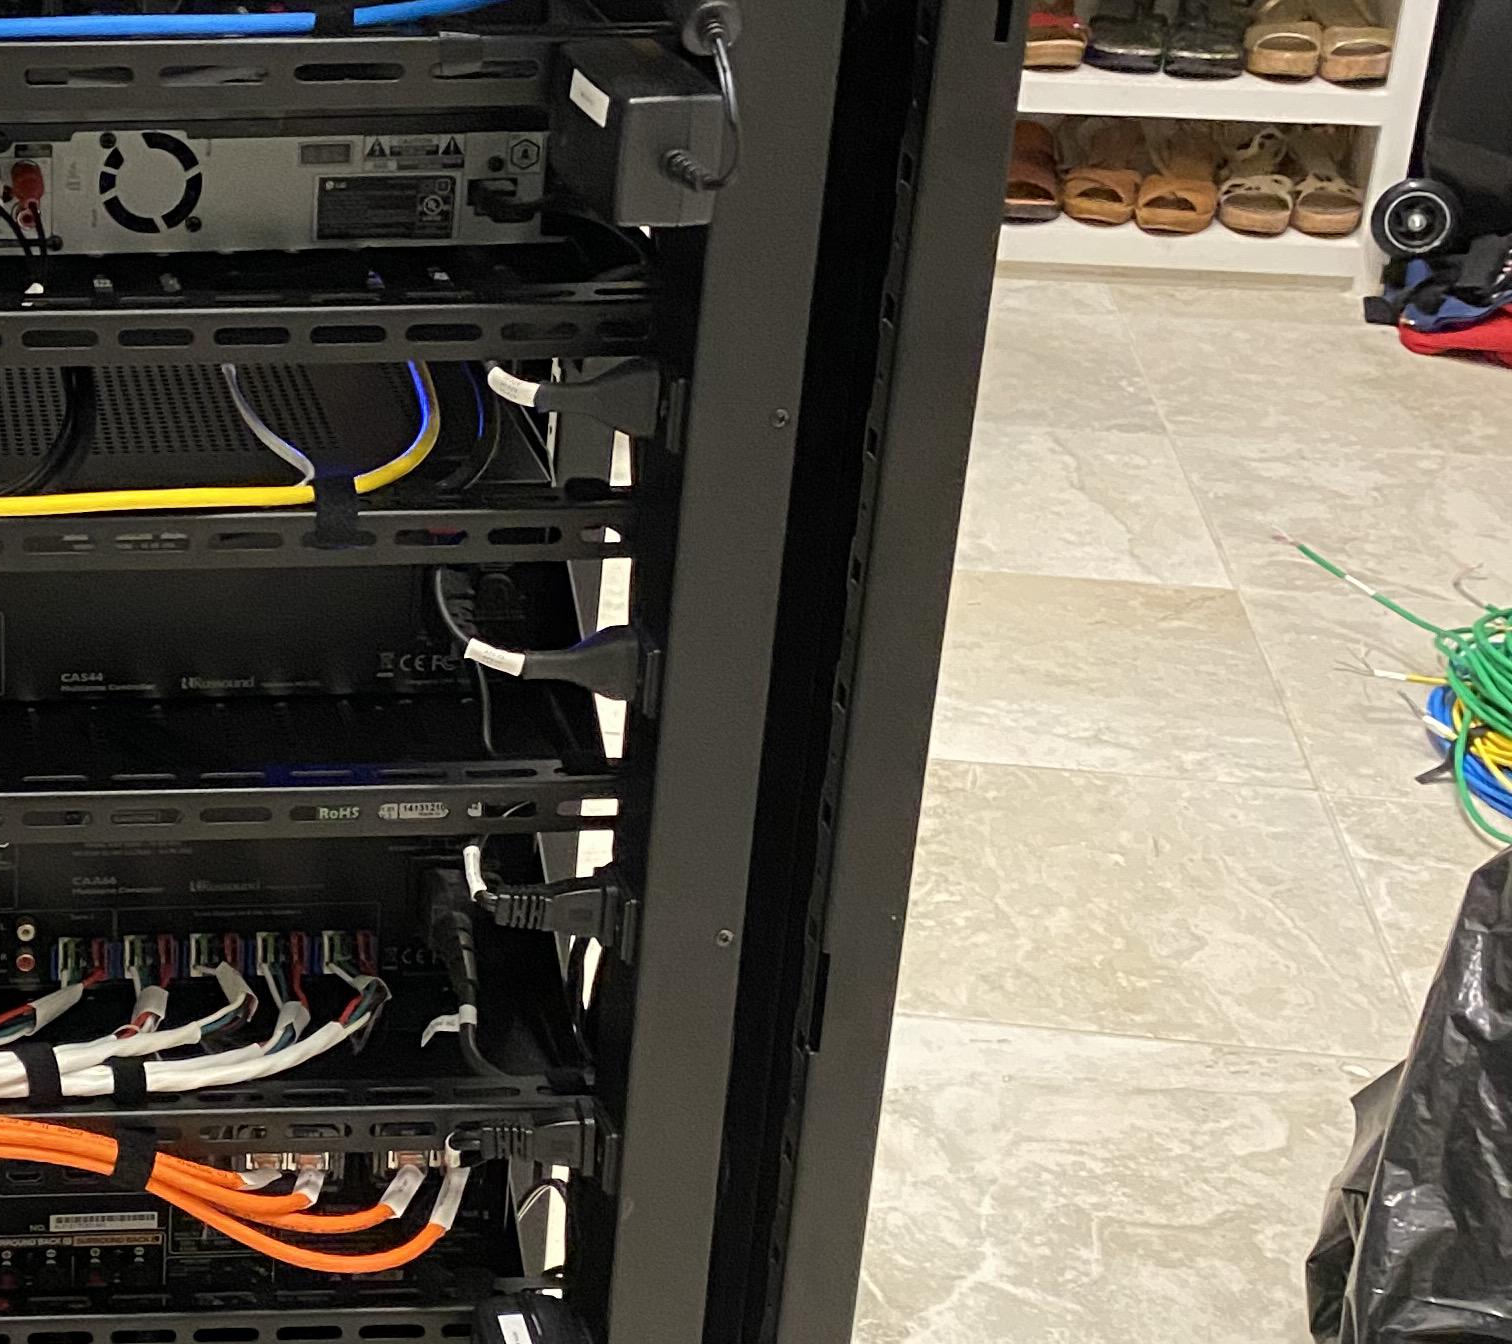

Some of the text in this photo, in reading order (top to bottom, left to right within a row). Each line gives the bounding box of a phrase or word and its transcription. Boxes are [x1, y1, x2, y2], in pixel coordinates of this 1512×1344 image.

[60, 672, 104, 682] CAS44
[191, 674, 256, 689] Russound
[318, 805, 360, 819] RoHS
[37, 1237, 62, 1246] BACK
